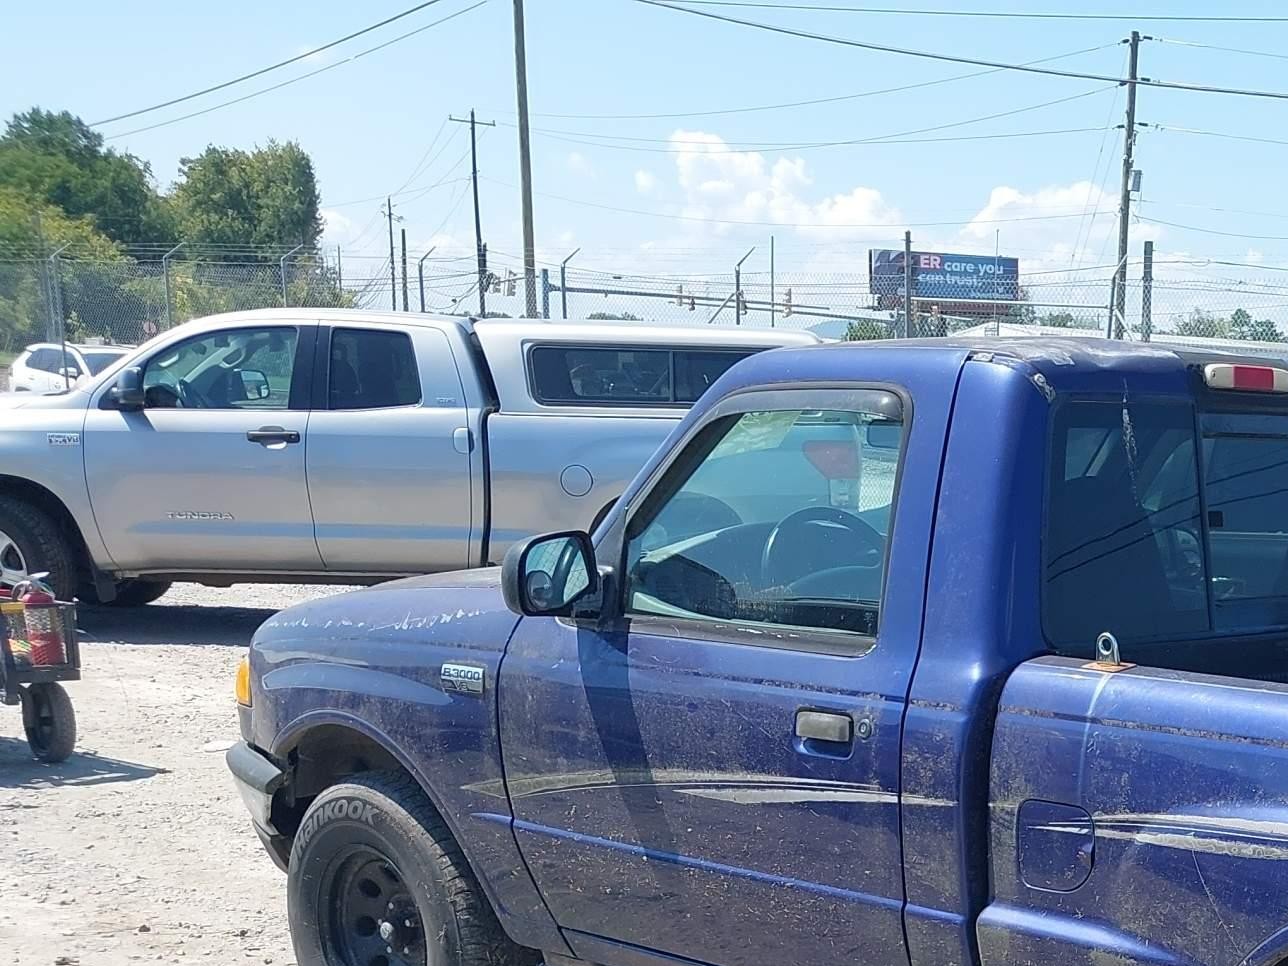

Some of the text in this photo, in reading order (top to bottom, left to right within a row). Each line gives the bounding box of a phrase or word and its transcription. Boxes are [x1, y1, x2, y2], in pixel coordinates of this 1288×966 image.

[919, 255, 1004, 276] ER care you
[165, 511, 235, 521] TUNDRA
[443, 667, 481, 681] B3000
